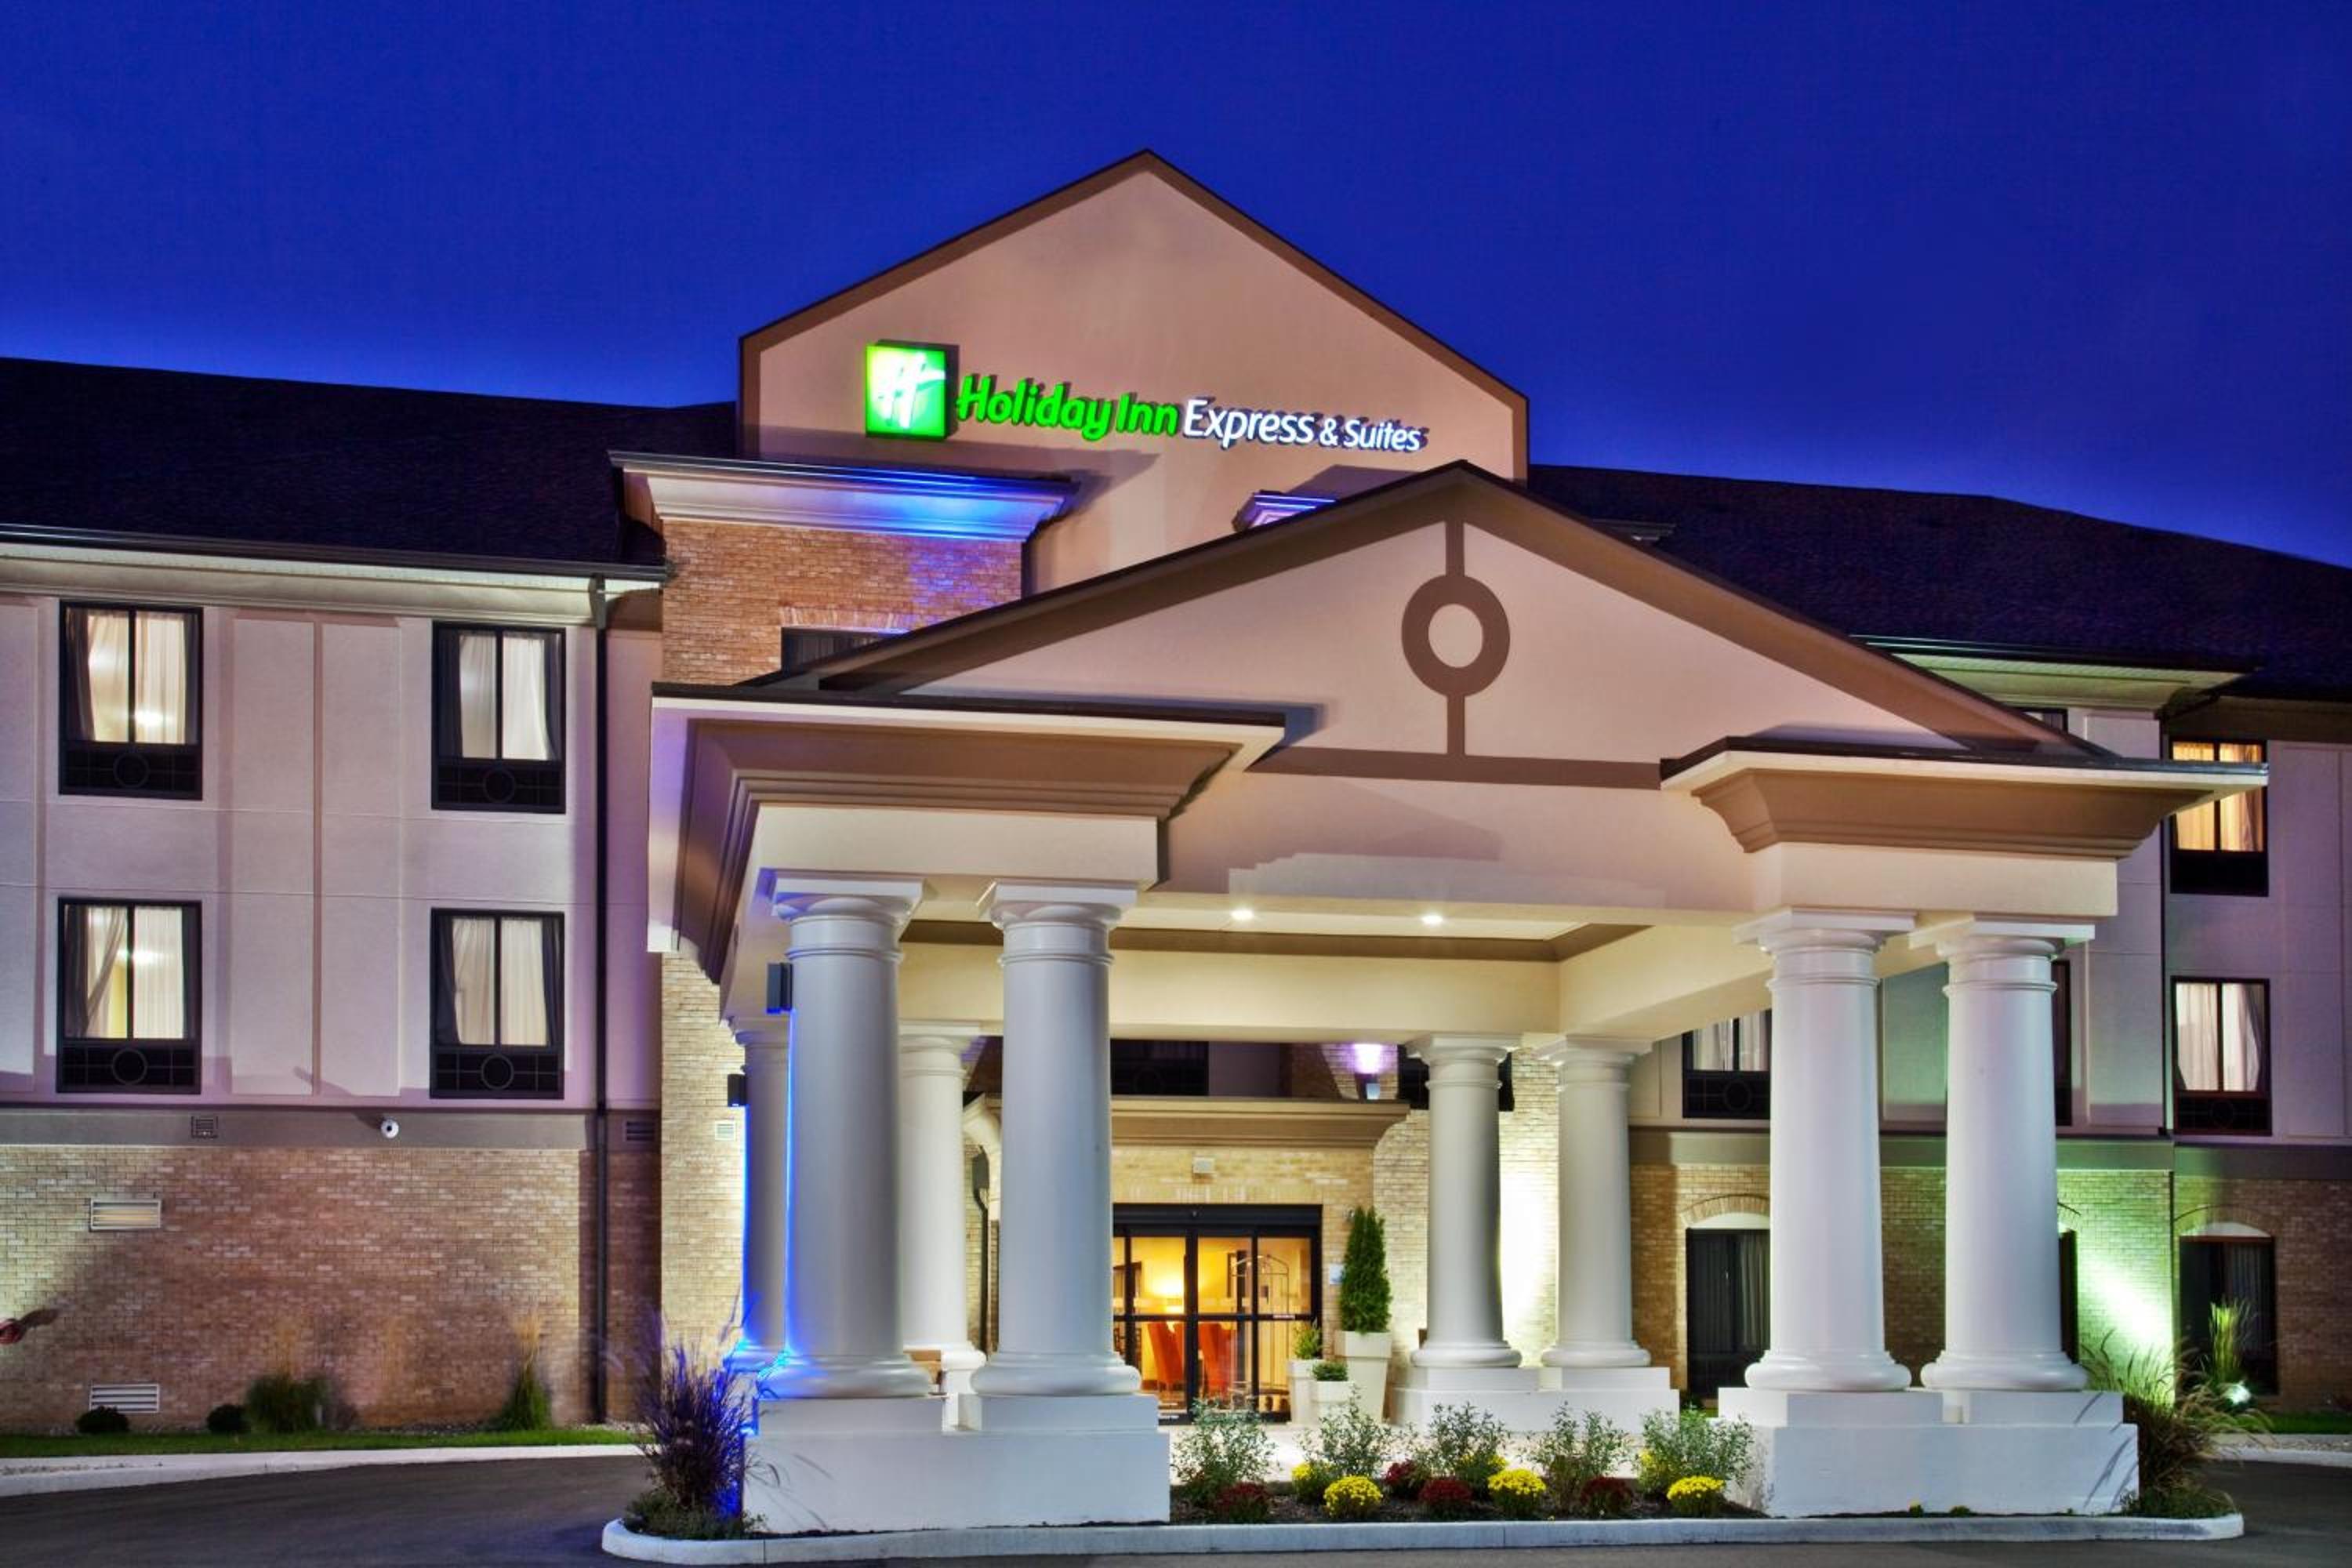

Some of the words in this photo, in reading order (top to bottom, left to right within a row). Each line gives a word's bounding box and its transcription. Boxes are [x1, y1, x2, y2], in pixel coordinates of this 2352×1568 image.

[956, 374, 1112, 441] Holiday
[1115, 392, 1179, 436] Inn
[1184, 398, 1316, 448] Express
[1319, 417, 1338, 446] &
[1342, 419, 1421, 451] Suites
